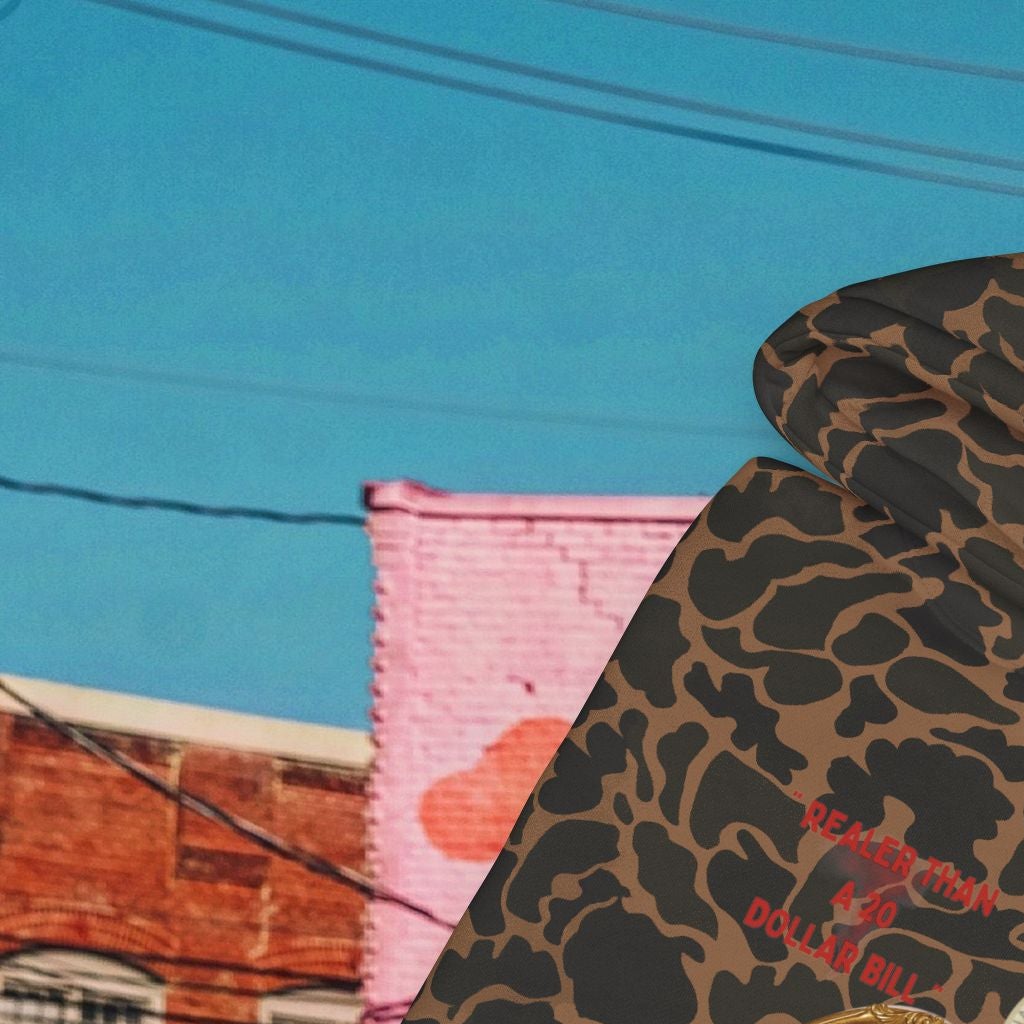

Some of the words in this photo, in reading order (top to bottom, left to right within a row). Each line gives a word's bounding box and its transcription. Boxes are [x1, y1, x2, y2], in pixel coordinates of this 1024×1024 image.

[829, 880, 856, 911] A
[857, 892, 898, 929] 20
[919, 856, 1000, 918] THAN
[743, 895, 859, 974] DOLLAR
